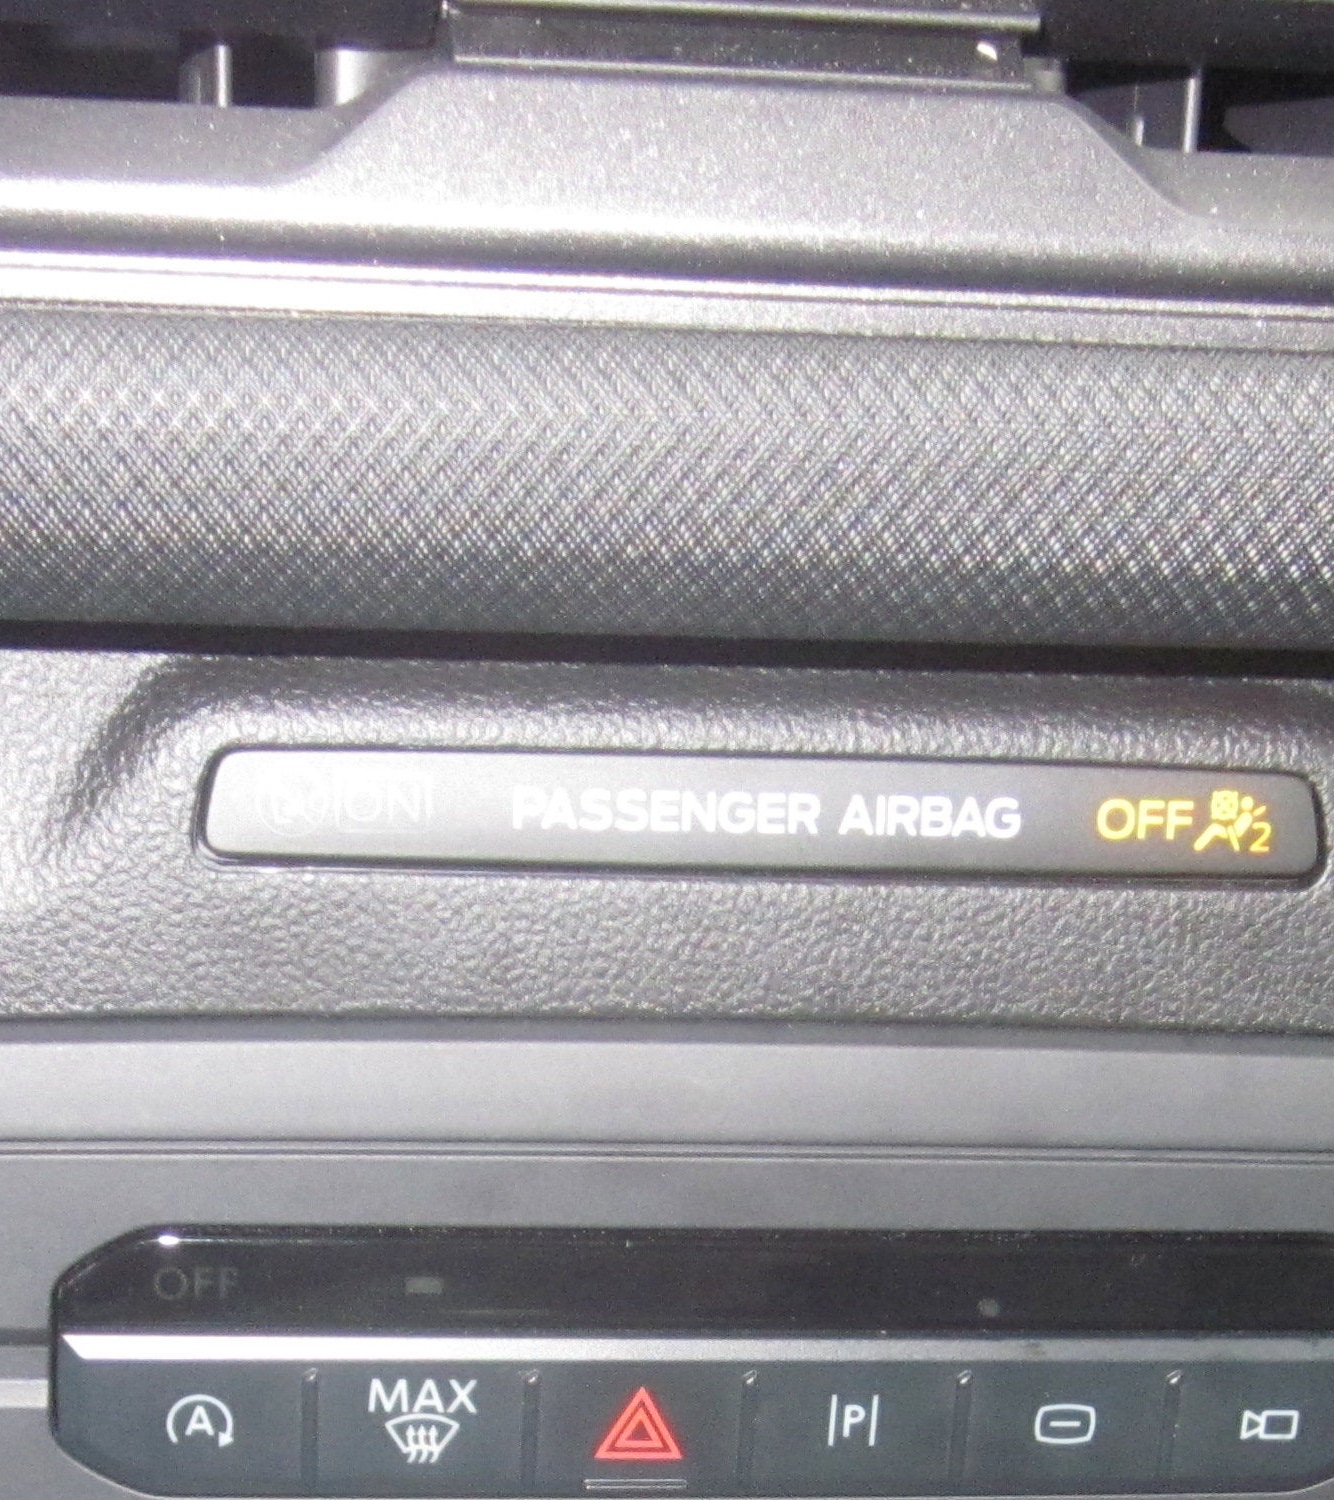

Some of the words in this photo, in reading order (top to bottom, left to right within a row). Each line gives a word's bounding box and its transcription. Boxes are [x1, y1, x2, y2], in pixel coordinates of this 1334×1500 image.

[511, 786, 821, 835] PASSENGER
[838, 793, 1022, 840] AIRBAG
[1097, 798, 1194, 840] OFF
[153, 1266, 240, 1300] OFF
[368, 1378, 478, 1414] MAX
